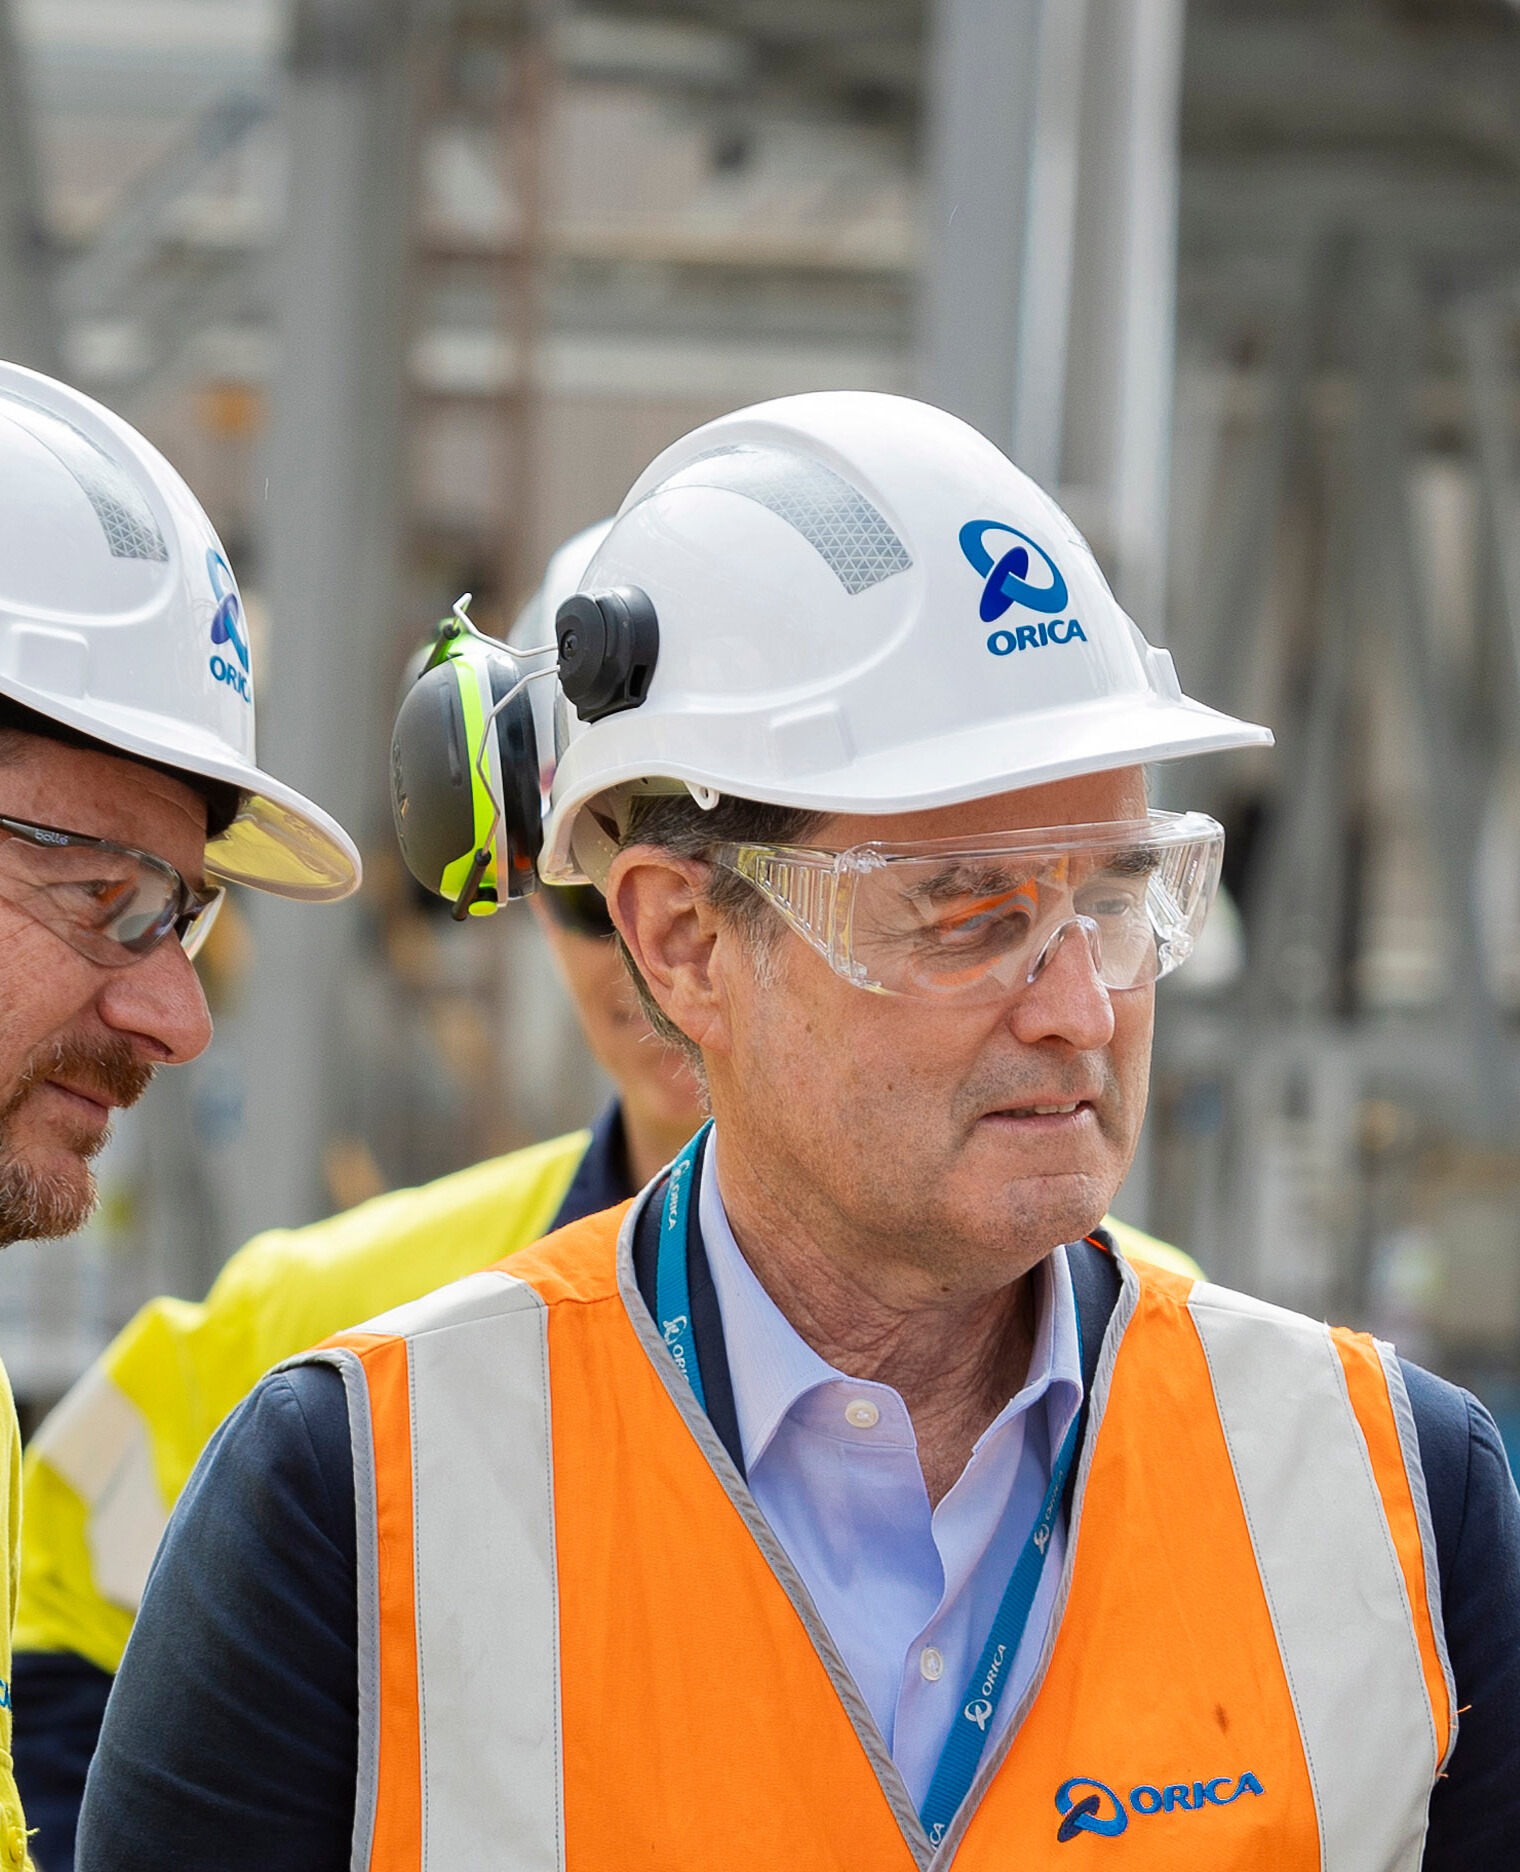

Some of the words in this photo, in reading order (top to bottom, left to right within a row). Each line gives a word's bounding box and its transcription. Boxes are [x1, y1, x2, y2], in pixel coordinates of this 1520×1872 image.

[986, 619, 1088, 656] ORICA
[208, 655, 252, 703] ORIC
[672, 1343, 690, 1382] ORI
[981, 1643, 1008, 1698] ORICA
[1129, 1770, 1266, 1815] ORICA
